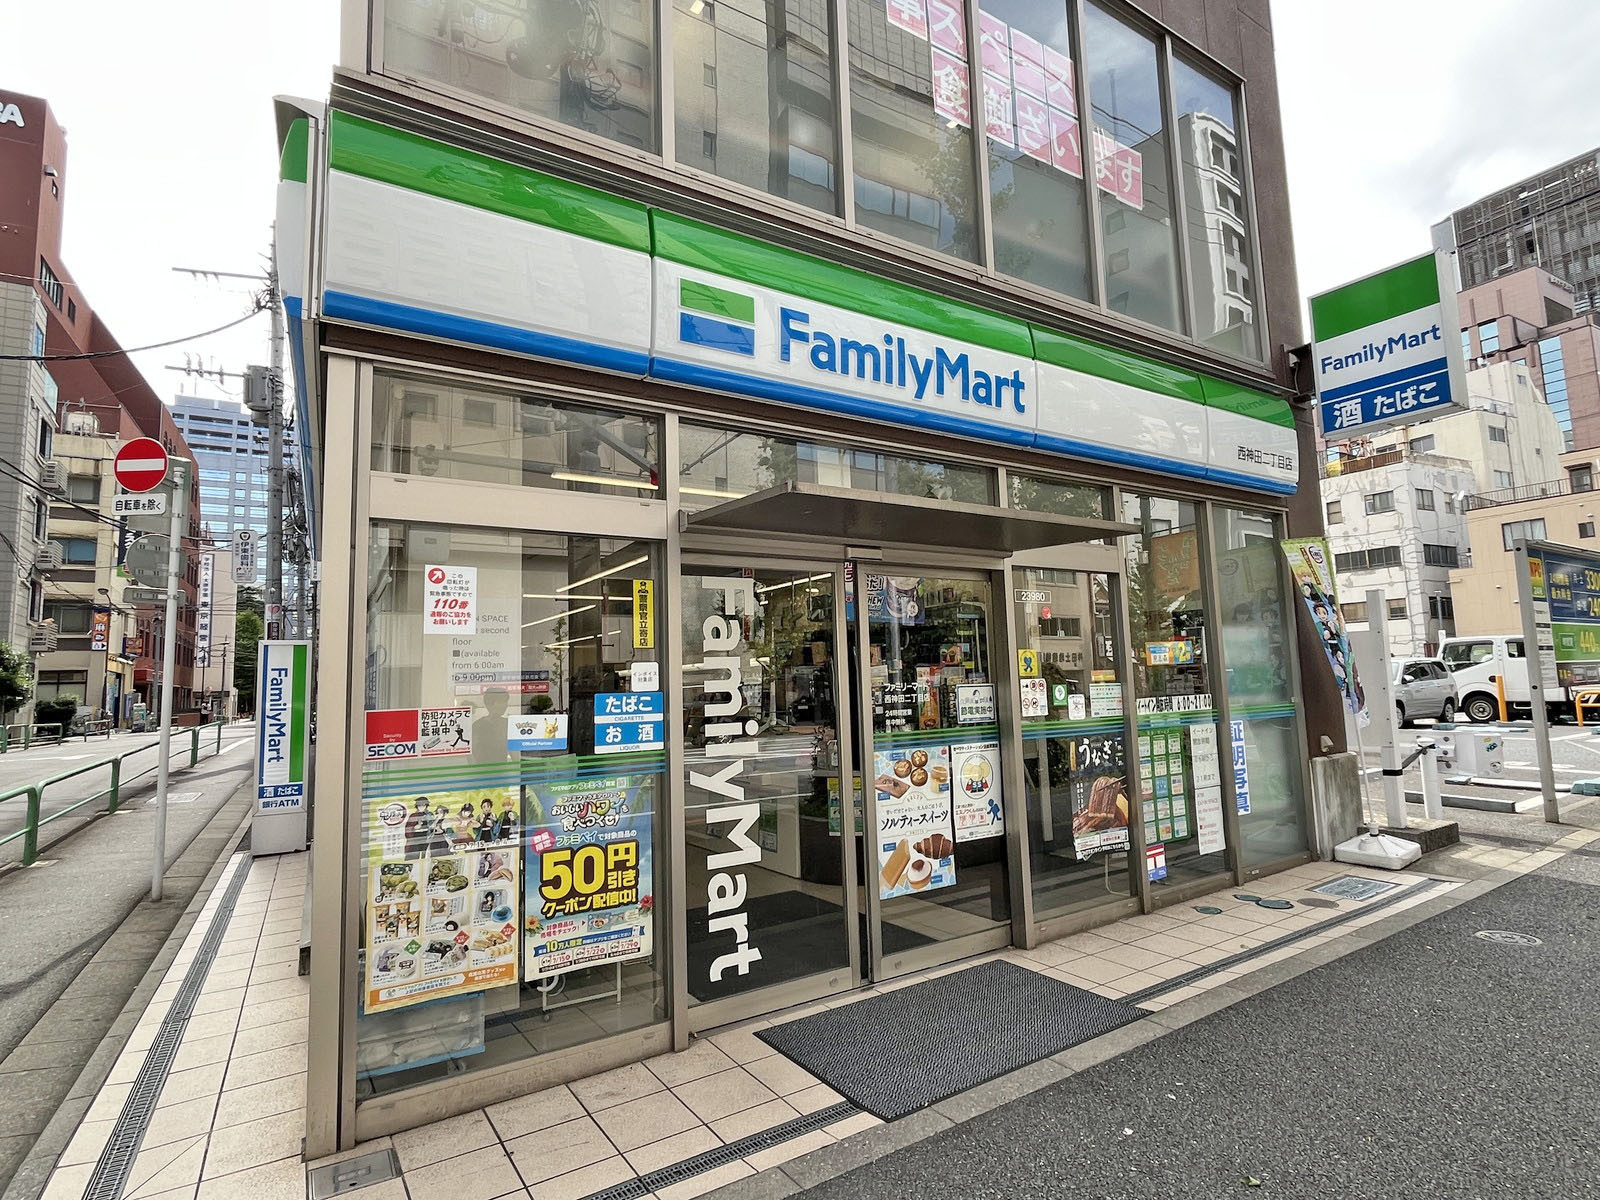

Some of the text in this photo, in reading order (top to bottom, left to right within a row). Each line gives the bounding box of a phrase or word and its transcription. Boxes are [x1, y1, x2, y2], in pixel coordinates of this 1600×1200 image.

[1321, 324, 1441, 374] FamilyMart
[780, 306, 1026, 413] FamilyMart
[1333, 381, 1440, 428] 酒 たばこ
[1238, 445, 1293, 471] 西神田二丁目店
[115, 499, 161, 511] 自転車を除く
[434, 599, 469, 610] 110番
[1021, 591, 1046, 601] 23980
[639, 594, 648, 647] 警察官立寄店
[461, 649, 500, 657] (available
[452, 661, 472, 669] from
[884, 682, 930, 692] ファミリーマート
[606, 695, 653, 713] たばこ
[884, 693, 931, 704] 西神田二丁目店
[268, 667, 289, 763] FamilyMart
[421, 710, 471, 720] 防犯カメラで
[421, 719, 458, 728] セコムが
[421, 727, 451, 736] 監視中
[606, 724, 654, 743] お 酒
[368, 743, 416, 757] SECOM
[1079, 737, 1113, 768] うなぎ
[689, 576, 763, 983] FamilyMart
[263, 786, 299, 797] 酒 たばこ
[262, 798, 300, 808] 銀行ATM
[551, 799, 630, 818] おいしいハワイを
[561, 814, 620, 832] 食べつくせ!
[880, 810, 949, 831] ソルティースイーツ
[541, 842, 637, 900] 50円
[607, 869, 636, 890] 引き
[542, 889, 637, 918] クーポン配信中!
[546, 920, 574, 931] 対象商品は
